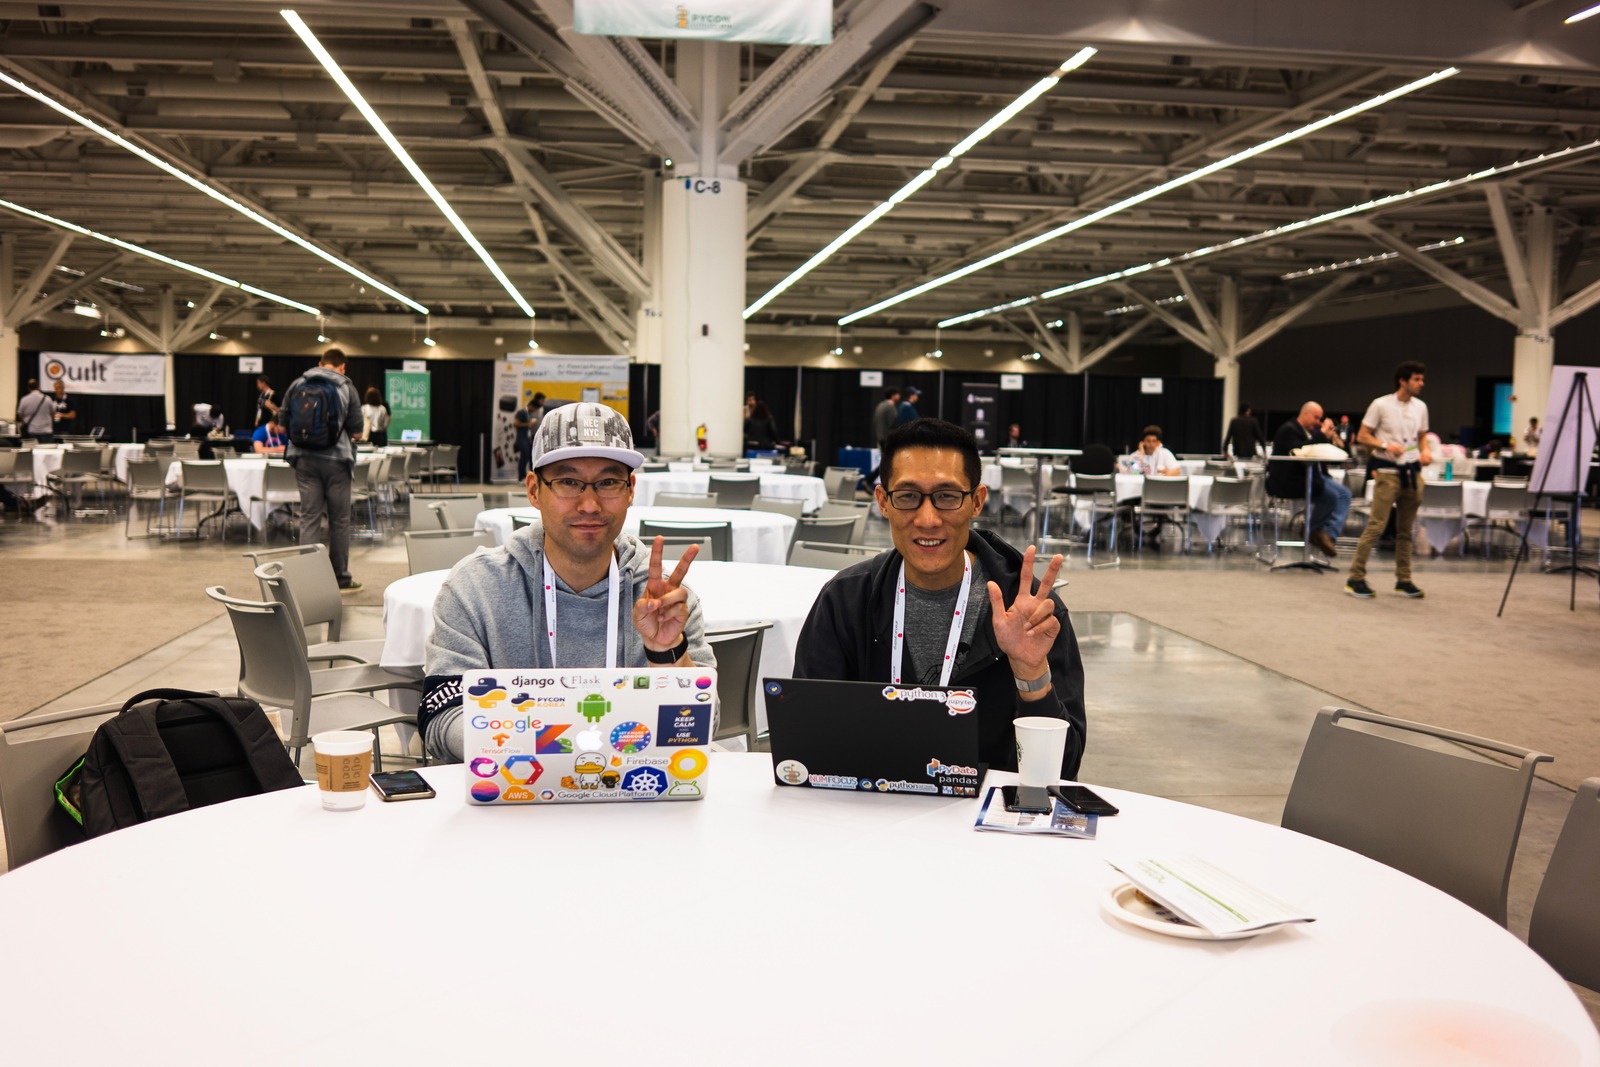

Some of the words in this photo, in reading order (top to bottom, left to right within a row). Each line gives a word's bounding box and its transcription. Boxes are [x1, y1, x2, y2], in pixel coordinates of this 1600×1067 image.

[694, 179, 721, 194] C-8
[45, 359, 107, 382] Quilt
[389, 391, 427, 409] Plus
[583, 418, 599, 427] NEC
[583, 428, 599, 437] NYC
[511, 676, 555, 688] django
[571, 675, 601, 685] Flask
[900, 689, 938, 701] python
[939, 693, 947, 702] 3
[947, 698, 976, 707] jupyter
[471, 715, 542, 734] Google
[626, 757, 669, 765] Firebase
[939, 765, 977, 775] PyData
[809, 775, 857, 785] NUMFOCUS
[938, 776, 978, 785] pandas
[889, 781, 918, 791] python
[558, 791, 590, 799] Google
